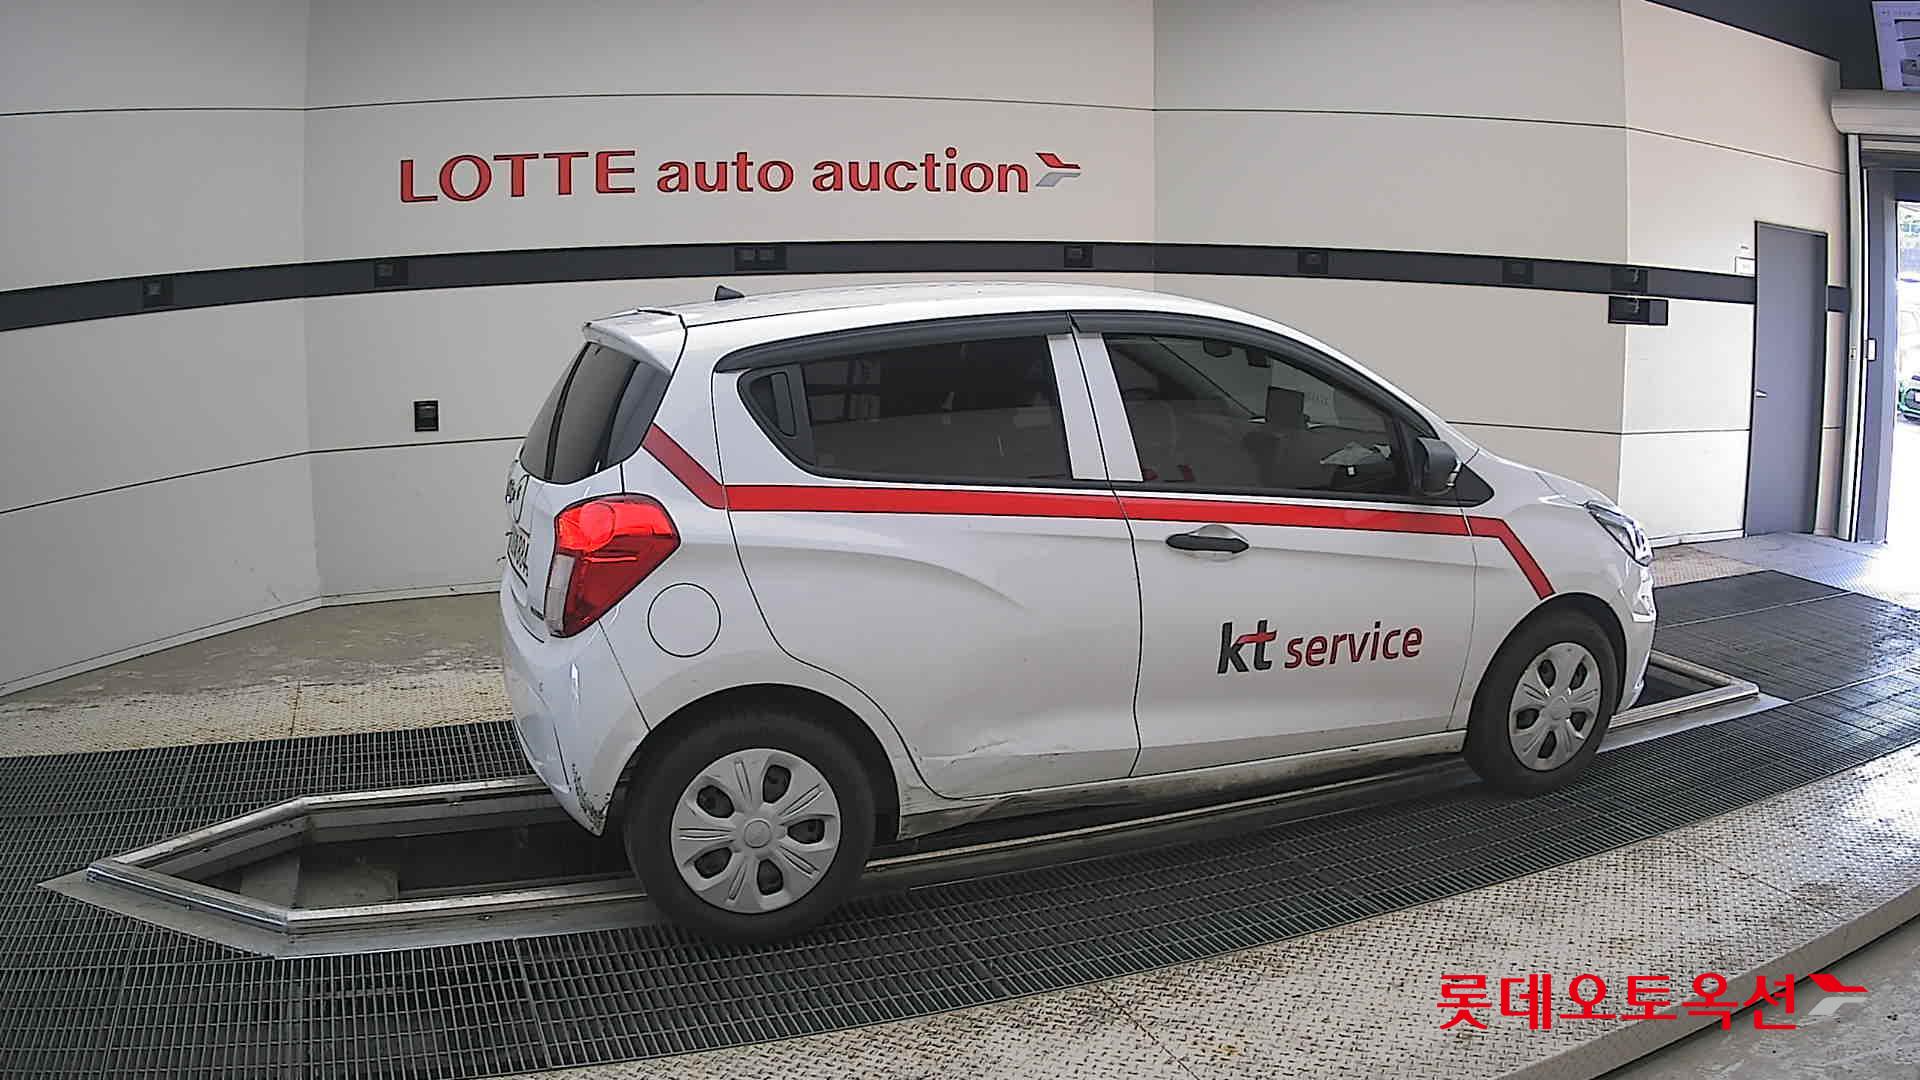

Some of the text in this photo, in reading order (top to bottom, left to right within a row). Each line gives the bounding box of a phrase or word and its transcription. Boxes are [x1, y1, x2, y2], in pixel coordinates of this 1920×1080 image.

[400, 146, 1029, 203] LOTTE auto auction
[1217, 619, 1423, 674] kt service
